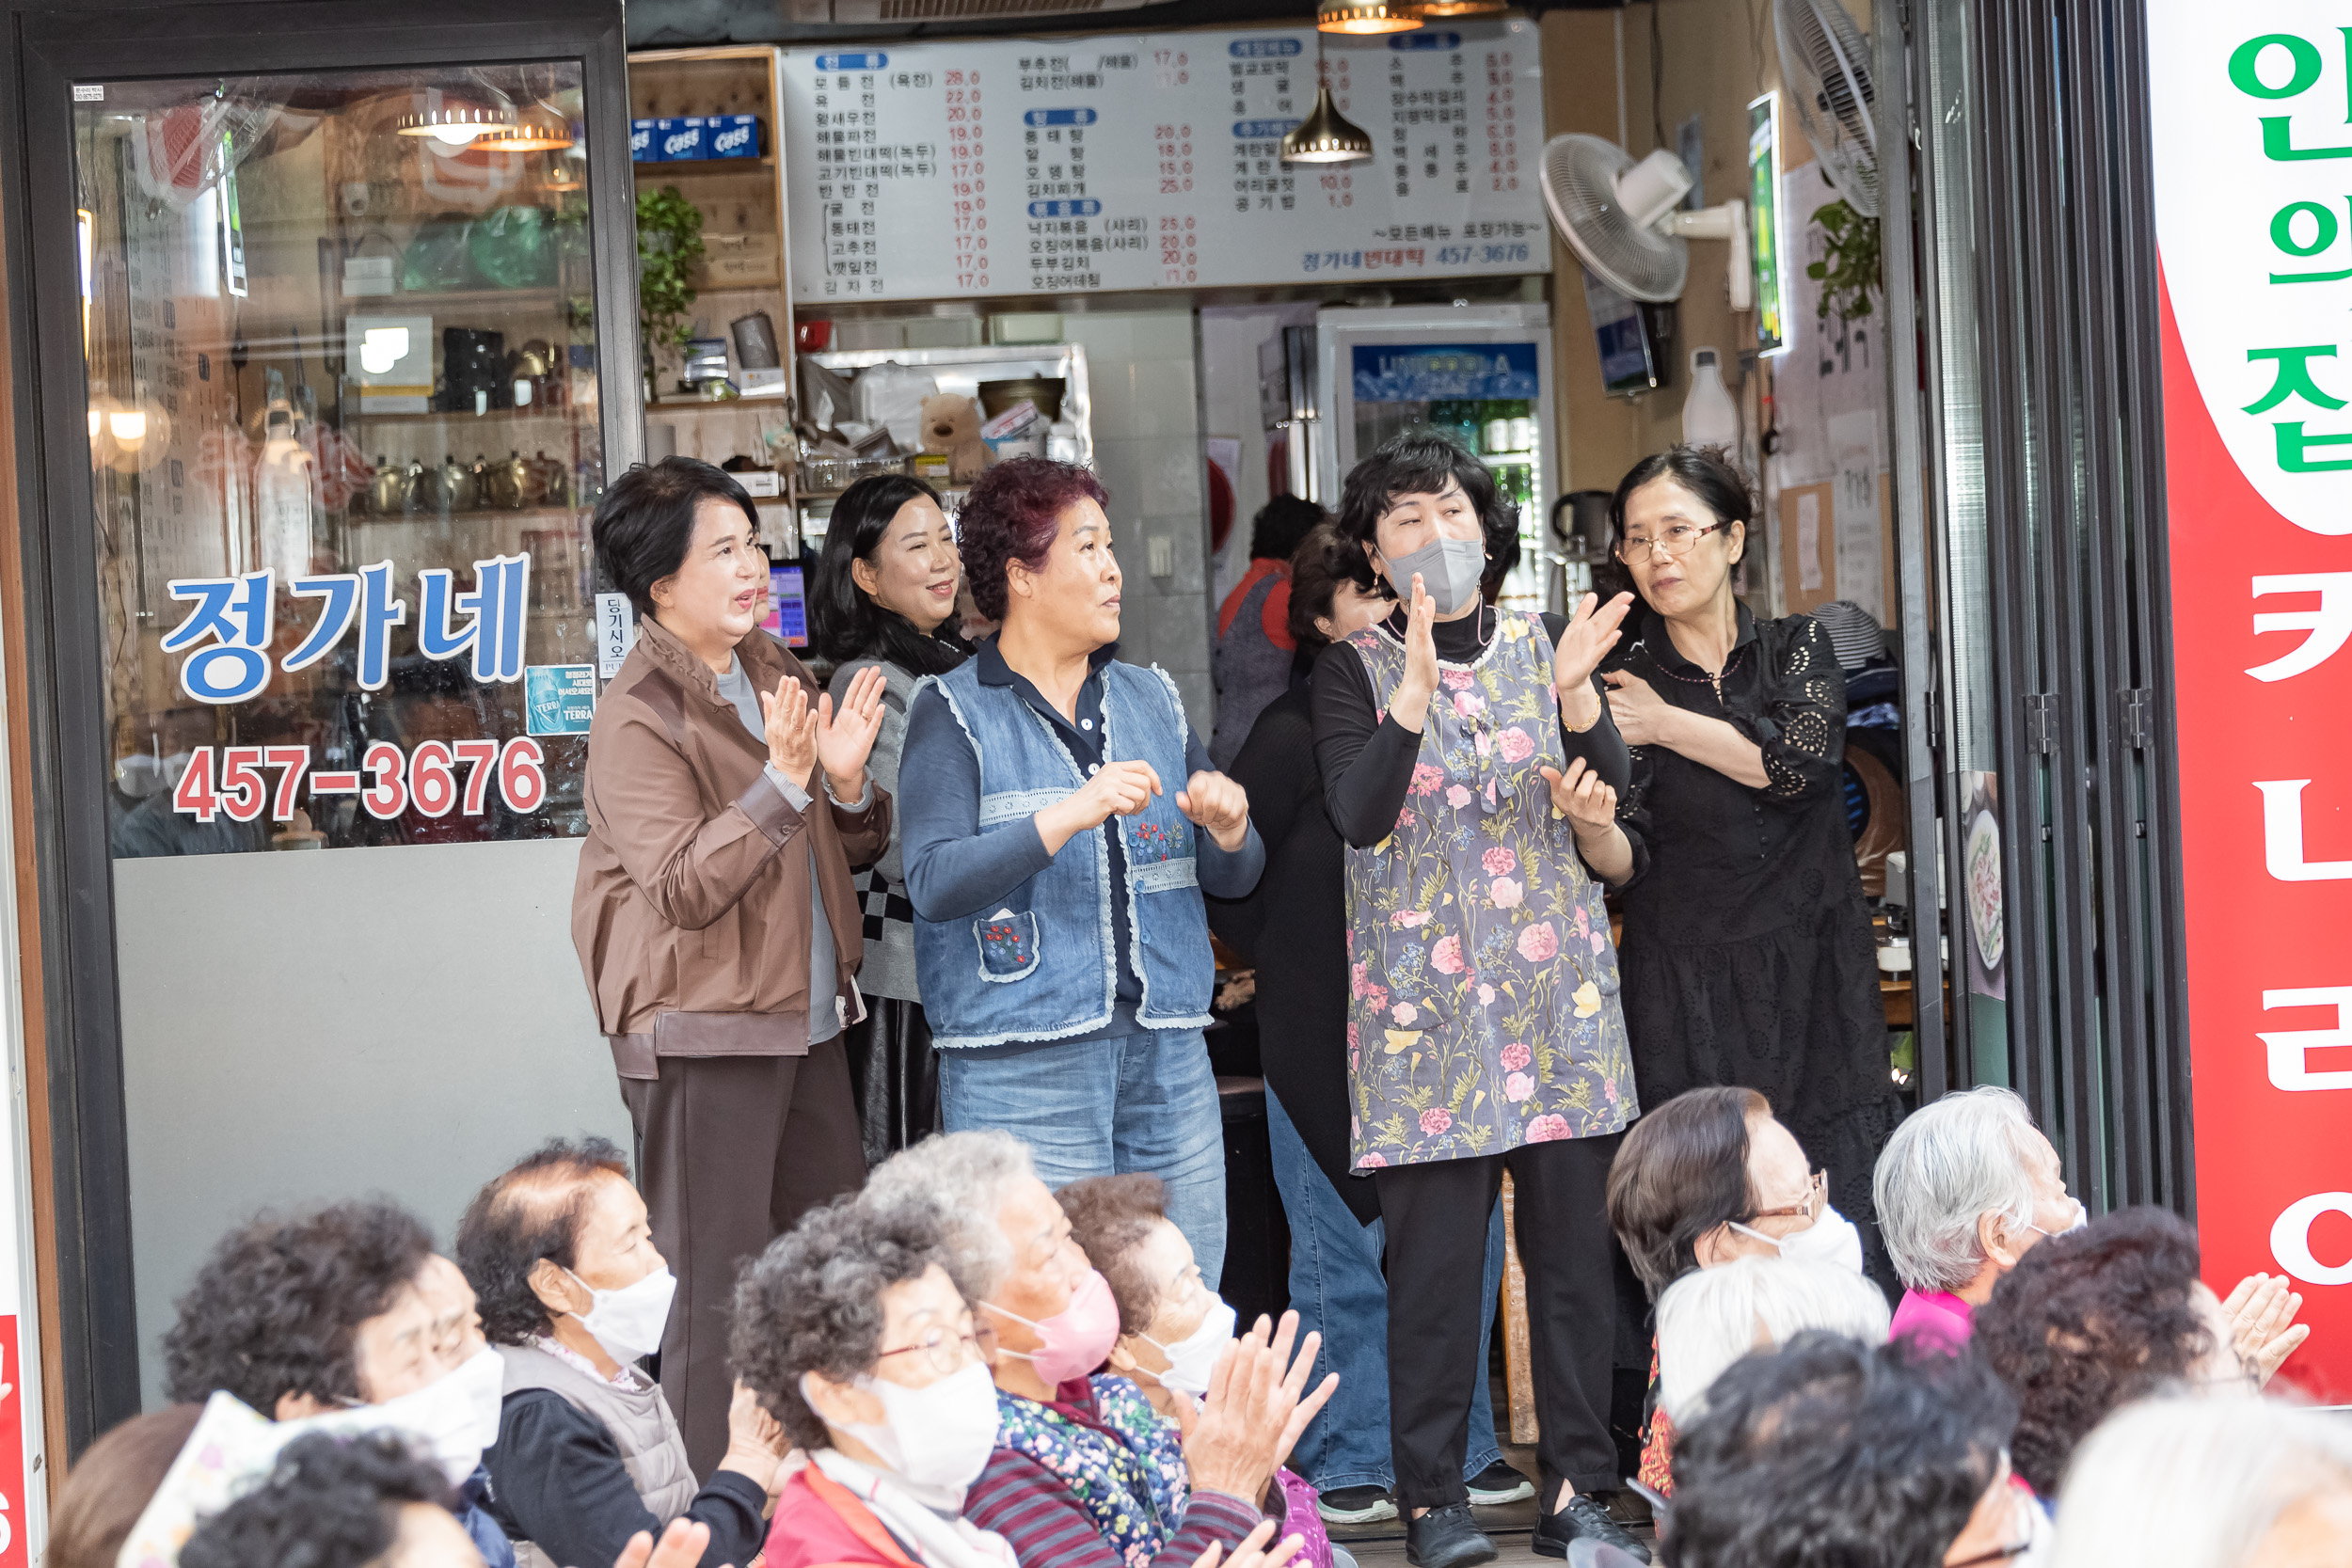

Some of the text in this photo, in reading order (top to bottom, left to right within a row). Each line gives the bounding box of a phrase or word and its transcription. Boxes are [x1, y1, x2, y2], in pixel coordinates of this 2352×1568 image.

[945, 71, 980, 86] 28.0
[946, 89, 981, 103] 22.0
[947, 106, 981, 122] 20.0
[817, 125, 982, 144] 해물파전 19.0
[1155, 124, 1191, 140] 20.0
[951, 143, 983, 159] 19.0
[951, 162, 984, 177] 17.0
[953, 180, 985, 196] 19.0
[954, 197, 985, 214] 19.0
[832, 217, 986, 236] 동태전 17.0
[1027, 216, 1195, 235] 낙지볶음 (사리) 25.0
[833, 236, 987, 255] 고추전 17.0
[1161, 233, 1196, 248] 20.0
[834, 255, 988, 276] 깻잎전 17.0
[1030, 250, 1197, 271] 두부김치 20.0
[958, 275, 989, 289] 17.0
[160, 551, 531, 705] 정가네
[564, 709, 594, 721] TERRA
[172, 736, 548, 822] 457-3676
